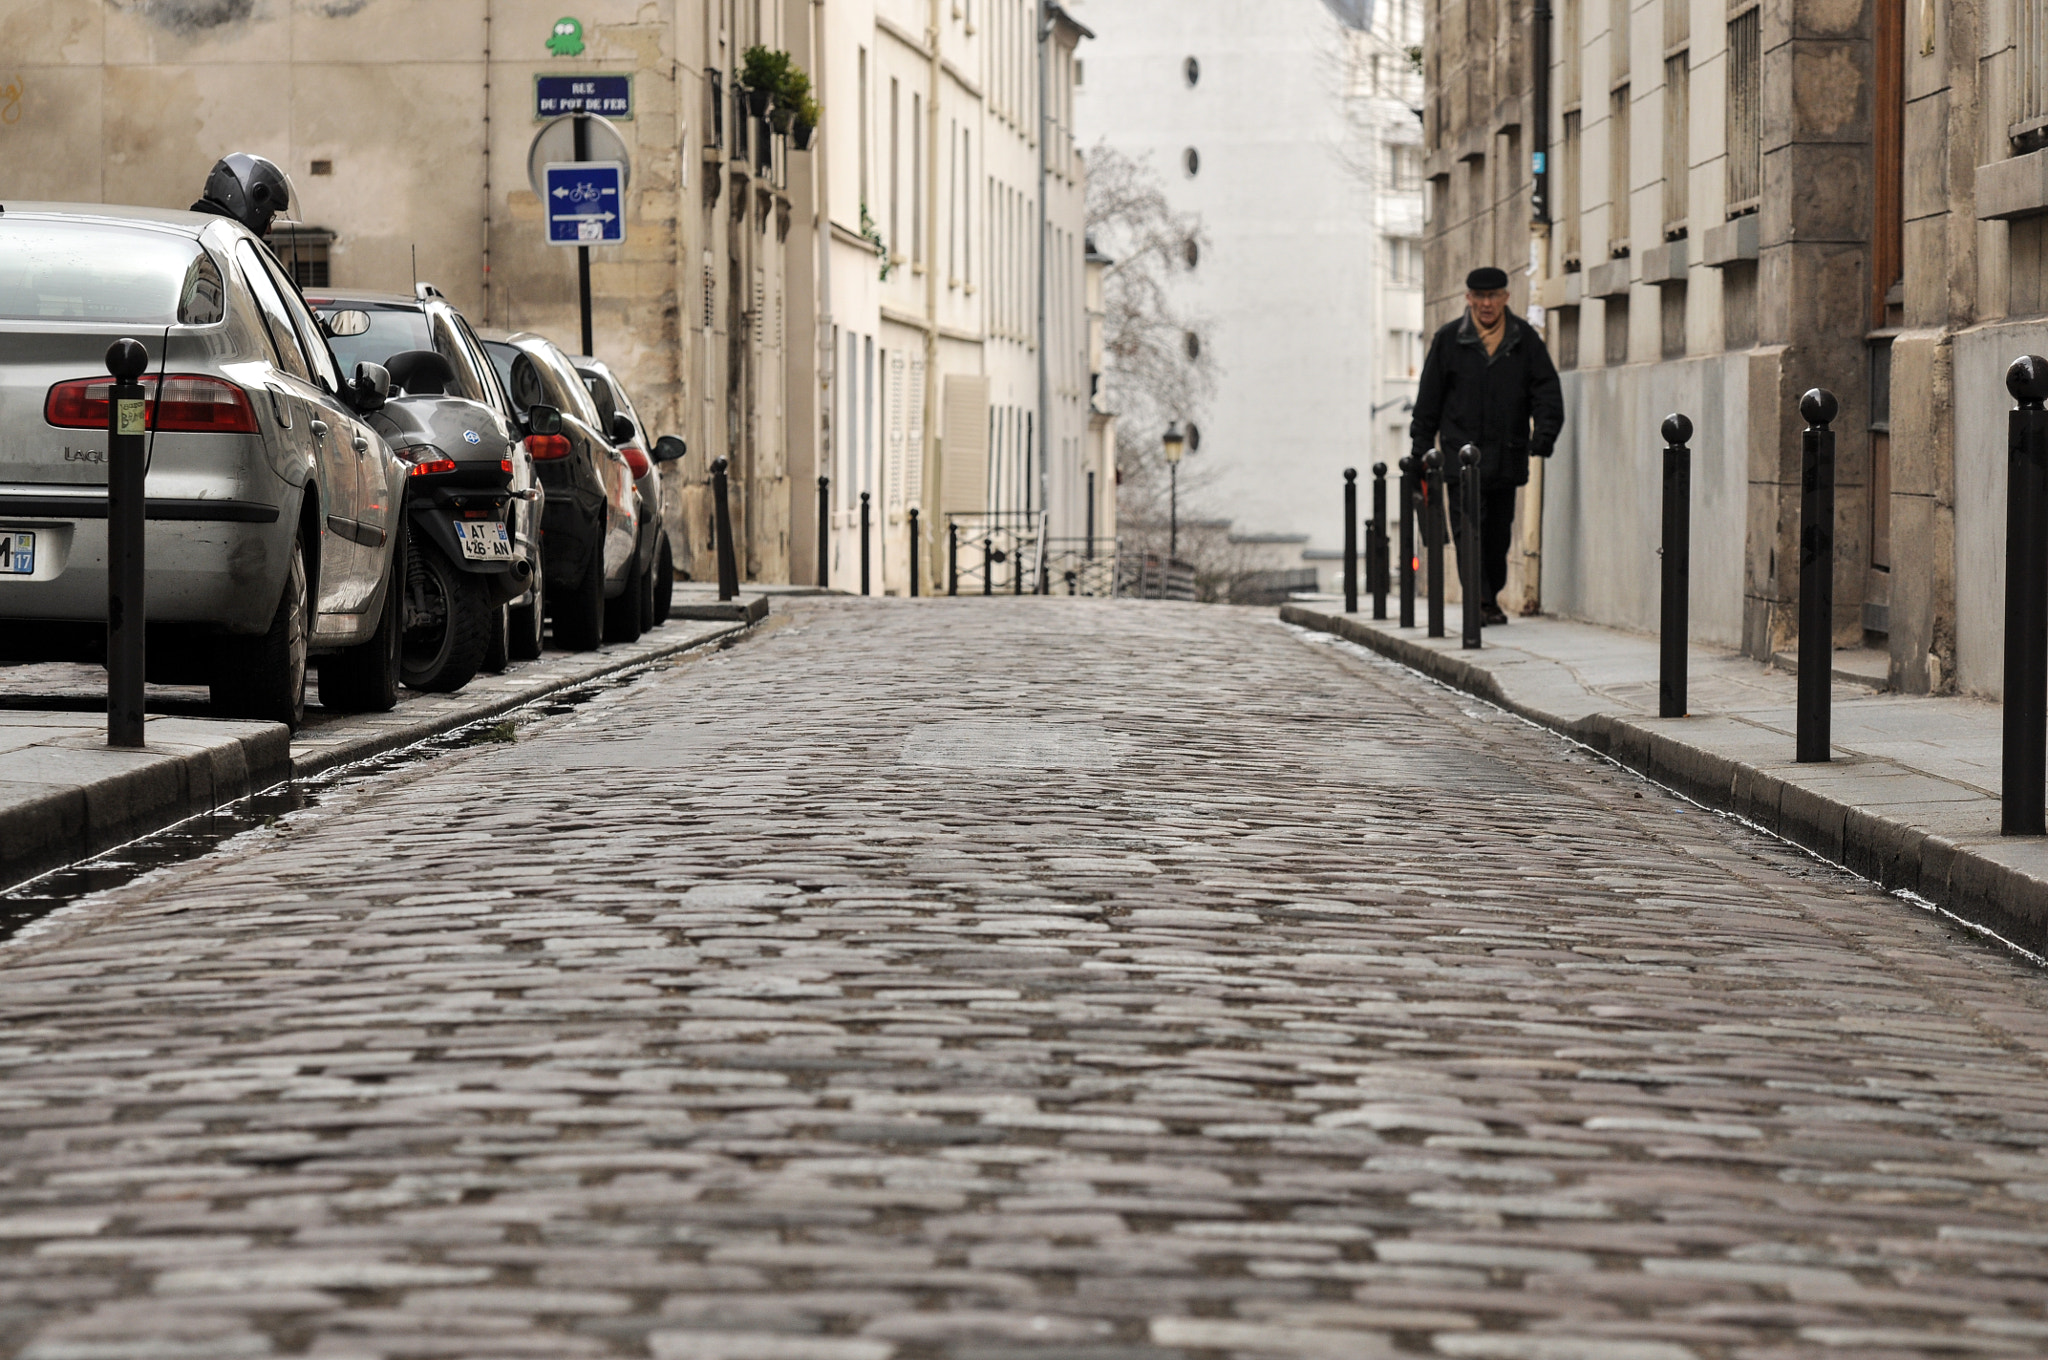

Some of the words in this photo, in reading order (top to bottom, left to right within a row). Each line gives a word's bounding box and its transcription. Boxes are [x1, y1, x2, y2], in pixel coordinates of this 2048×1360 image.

[572, 82, 595, 95] RUE
[541, 98, 557, 110] DU
[560, 98, 583, 110] POT
[586, 98, 601, 110] DE
[603, 98, 627, 110] FER
[64, 446, 109, 464] LAGU
[471, 524, 485, 539] AT
[16, 554, 31, 569] 17
